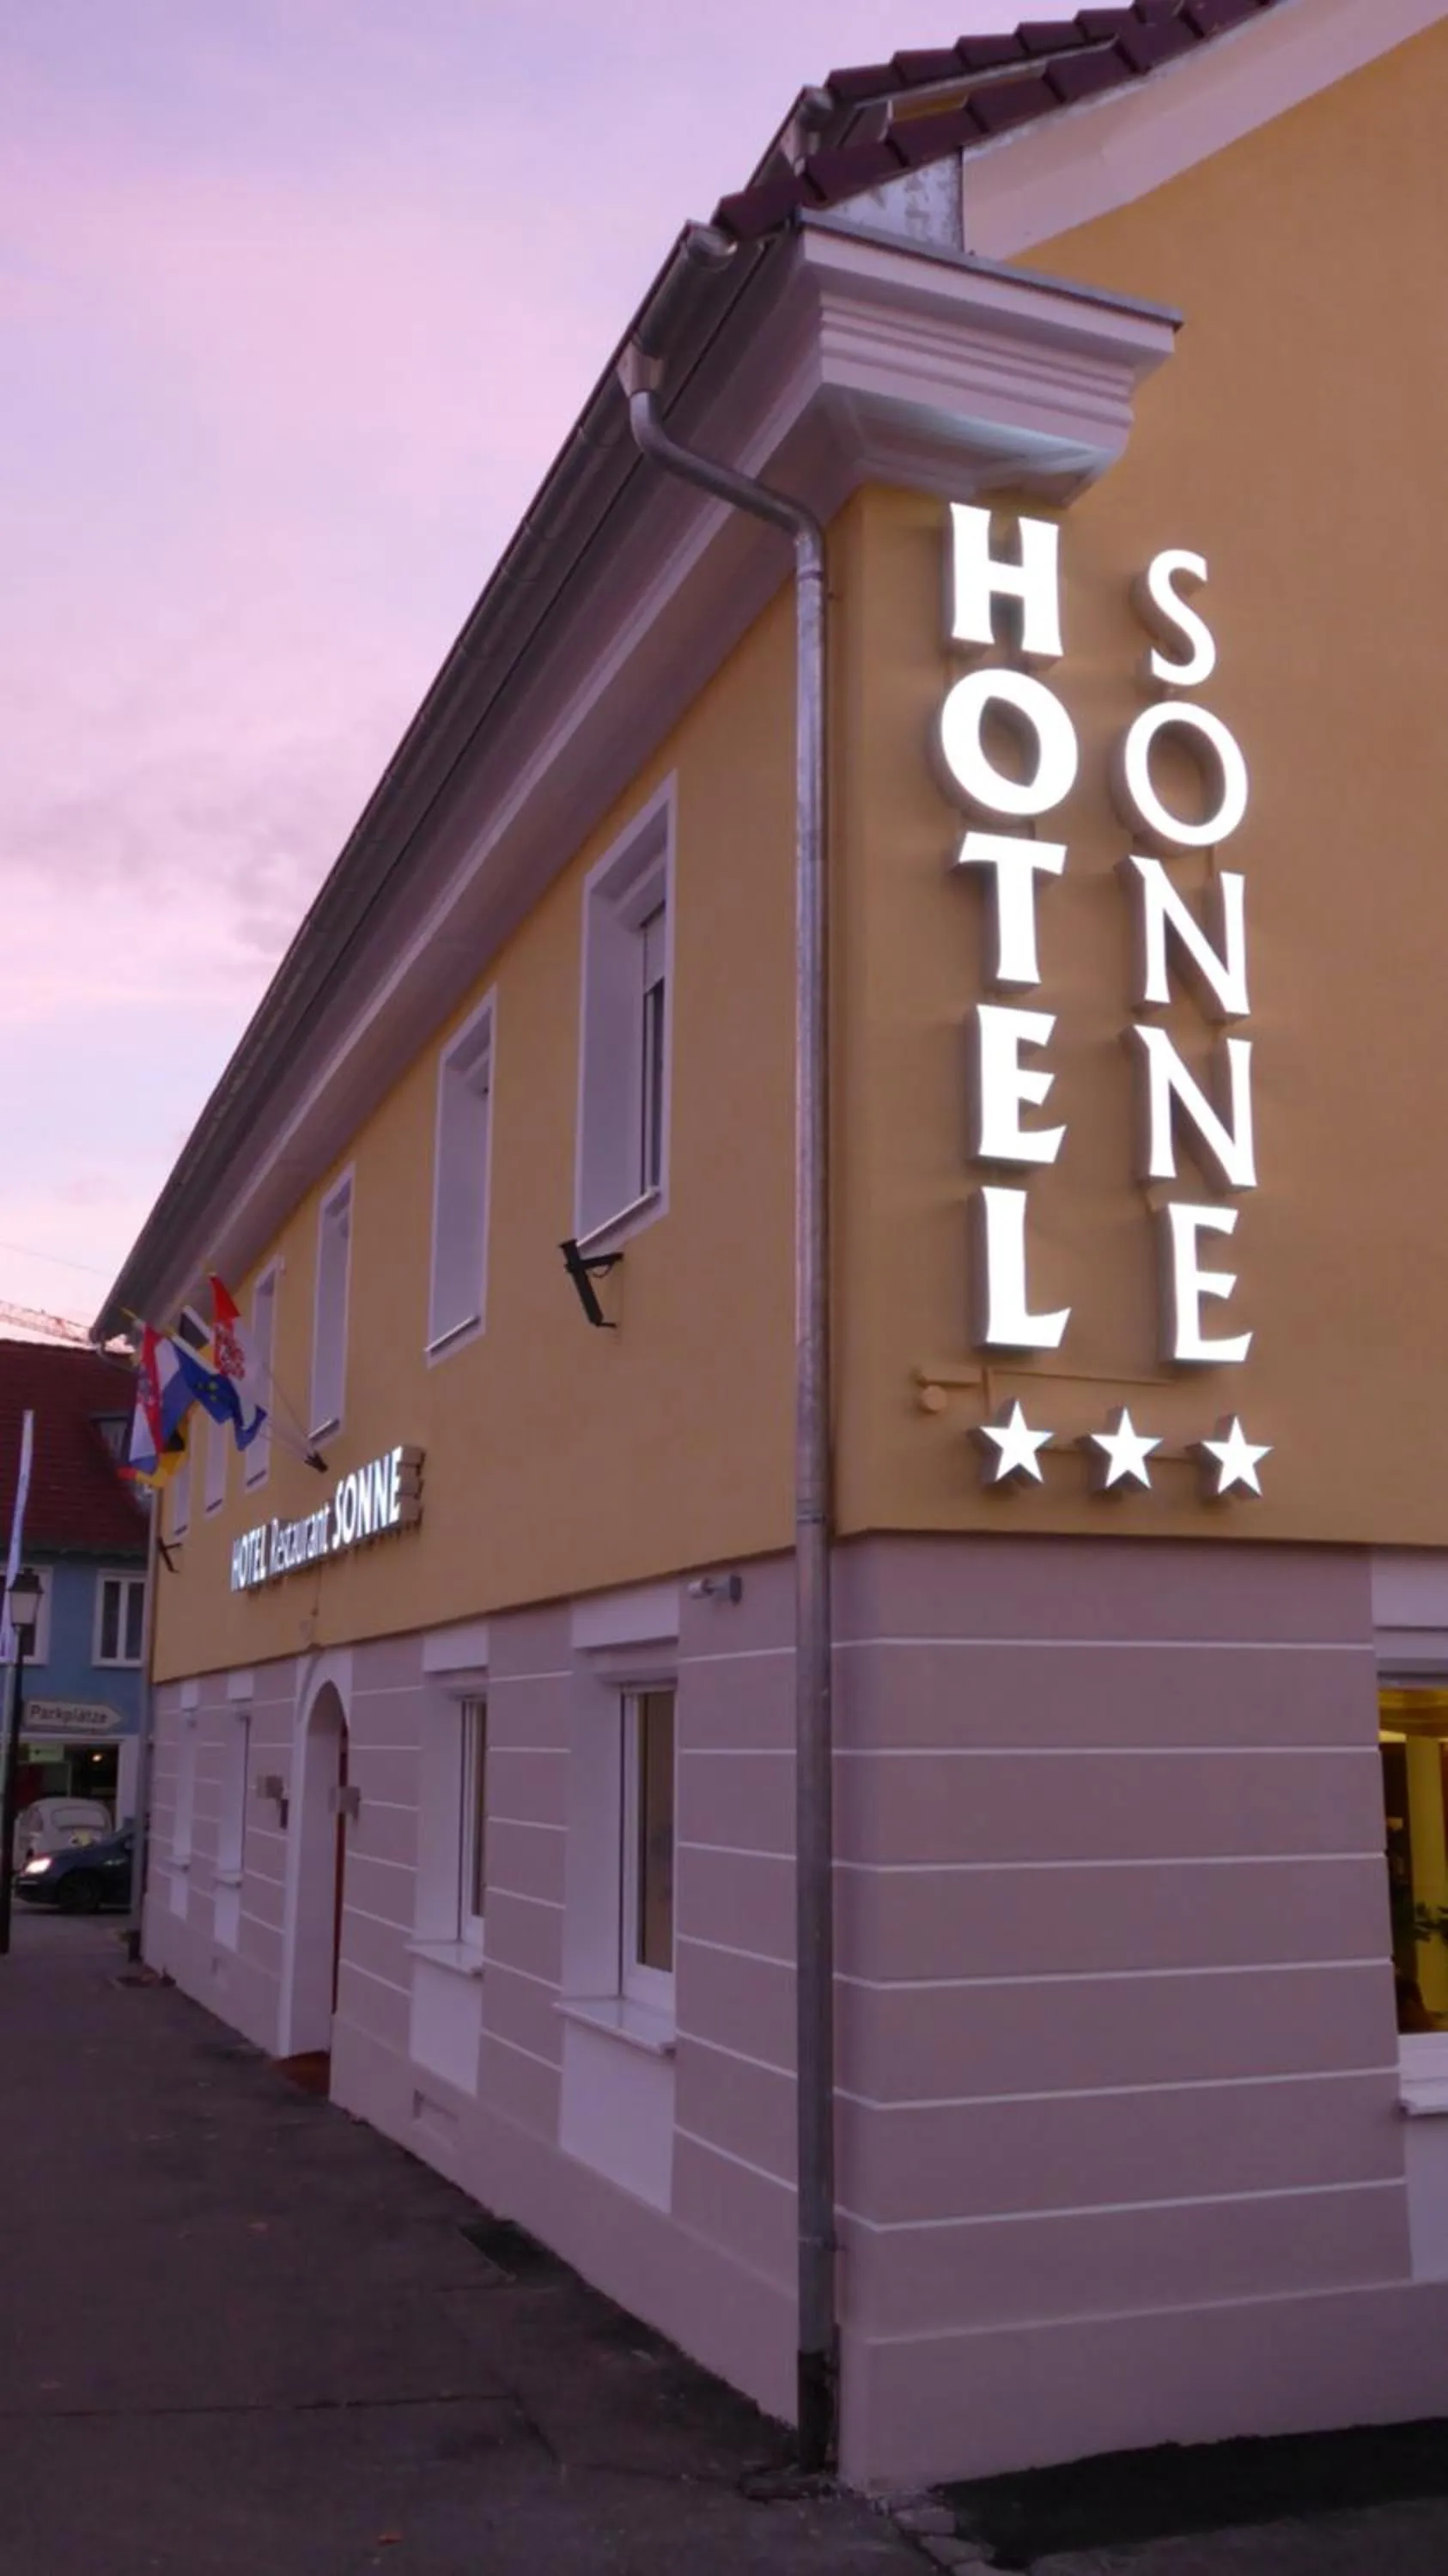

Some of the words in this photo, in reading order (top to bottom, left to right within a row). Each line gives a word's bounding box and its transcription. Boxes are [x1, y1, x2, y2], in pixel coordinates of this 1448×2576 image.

[940, 503, 1078, 1349] HOTEL
[1123, 550, 1256, 1363] SONNE
[231, 1525, 265, 1592] HOTEL
[271, 1504, 330, 1575] Restaurant
[332, 1446, 403, 1550] SONNE
